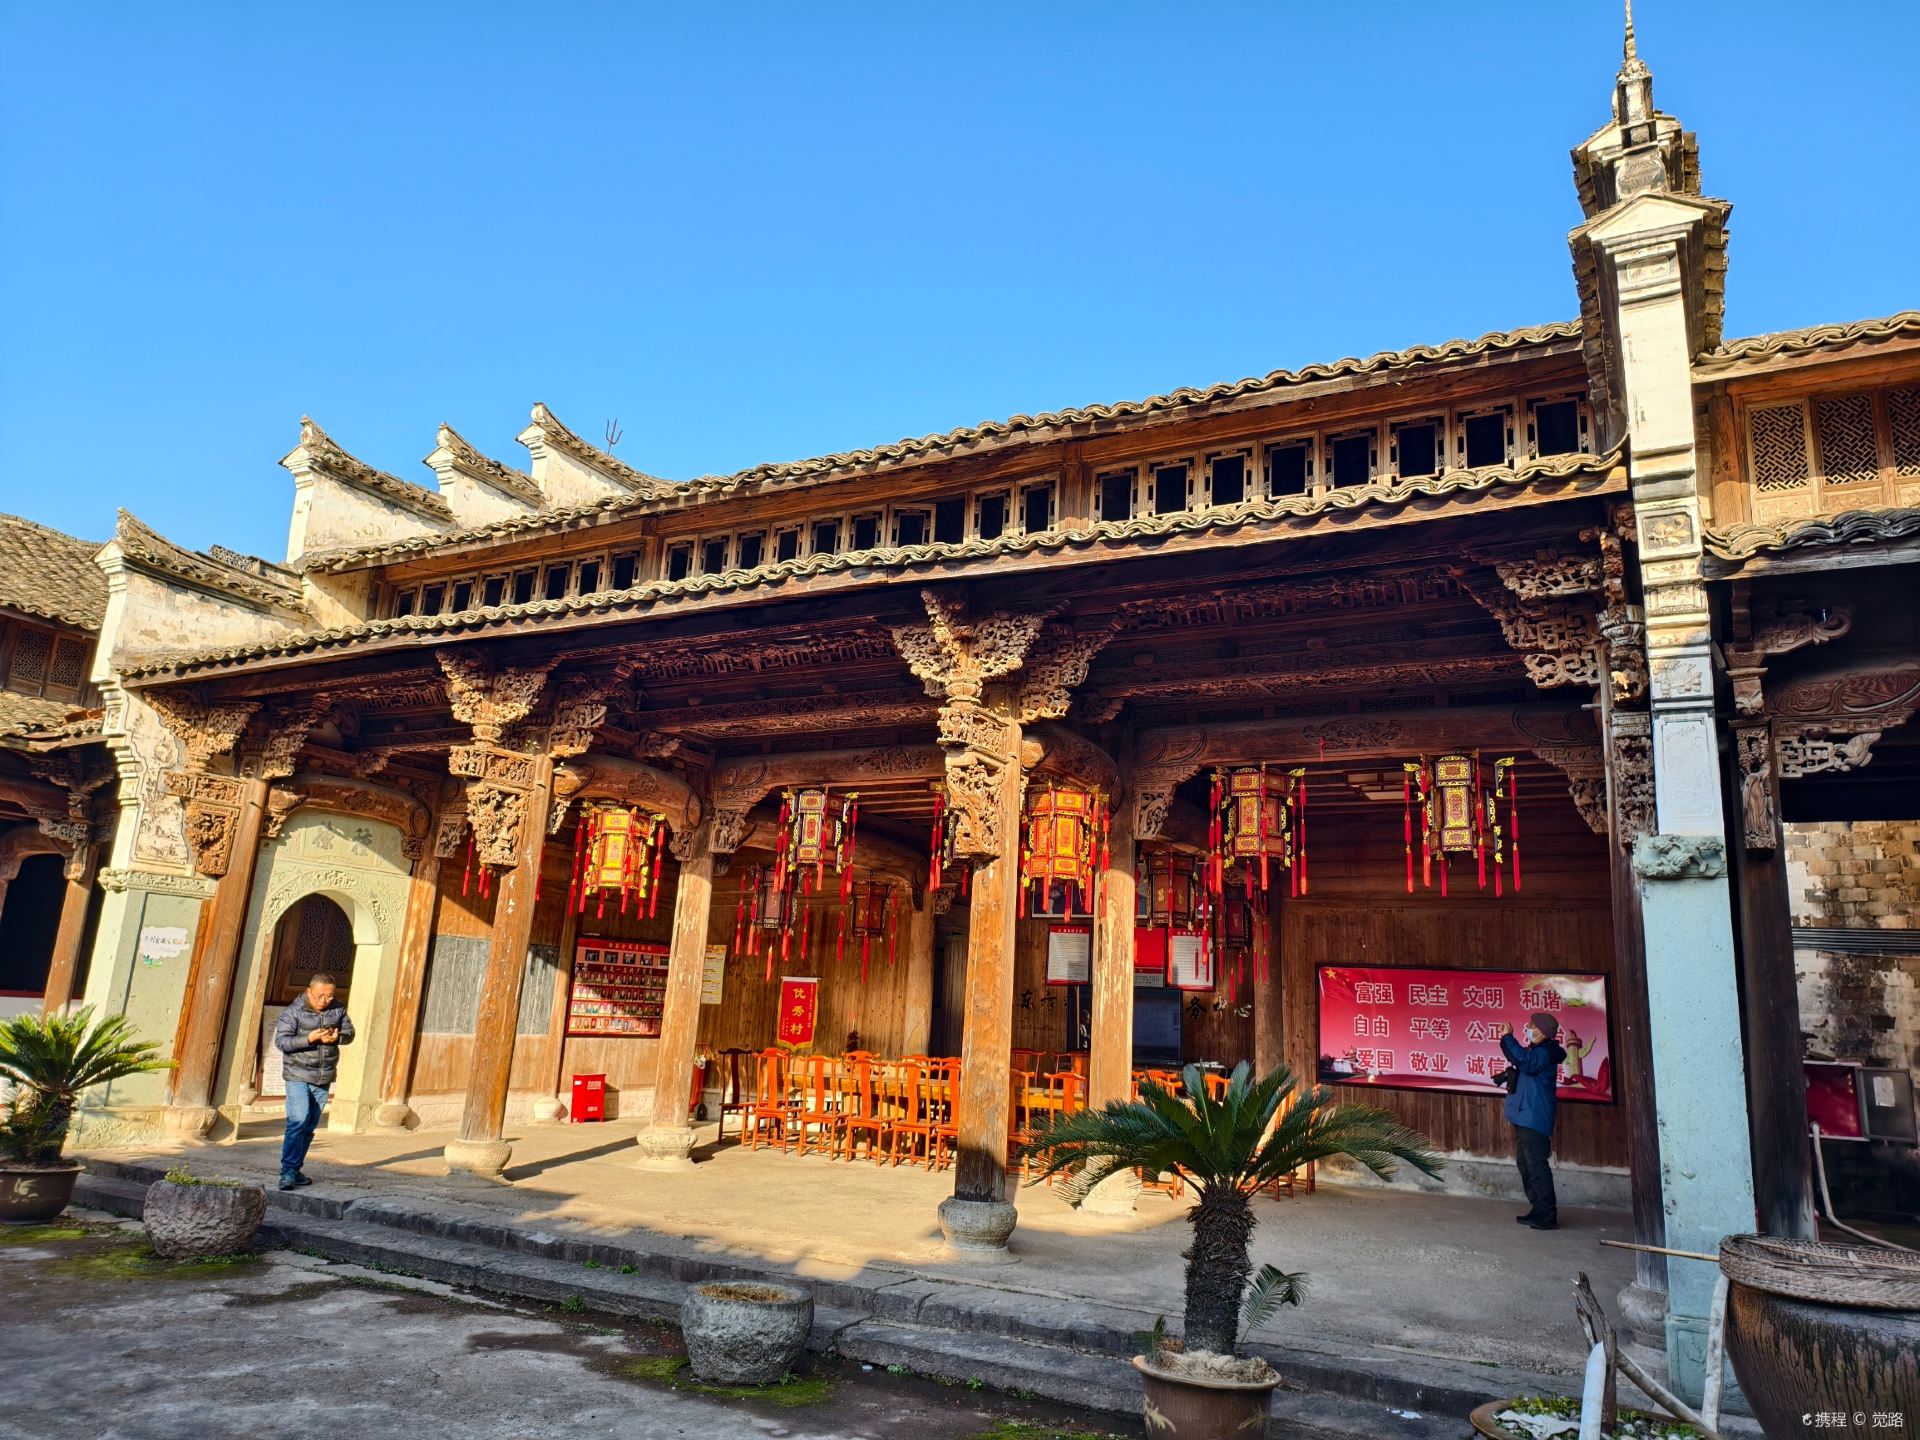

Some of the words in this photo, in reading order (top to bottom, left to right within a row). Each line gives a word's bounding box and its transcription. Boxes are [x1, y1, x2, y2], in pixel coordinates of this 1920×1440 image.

[1355, 982, 1394, 1003] 富强
[1409, 984, 1448, 1006] 民主
[1463, 986, 1504, 1008] 文明
[1520, 988, 1561, 1011] 和谐
[1354, 1014, 1389, 1036] 自由
[1410, 1017, 1450, 1040] 平等
[1465, 1020, 1502, 1042] 公正
[1357, 1048, 1394, 1070] 爱国
[1410, 1051, 1449, 1073] 敬业
[1466, 1054, 1506, 1076] 诚信
